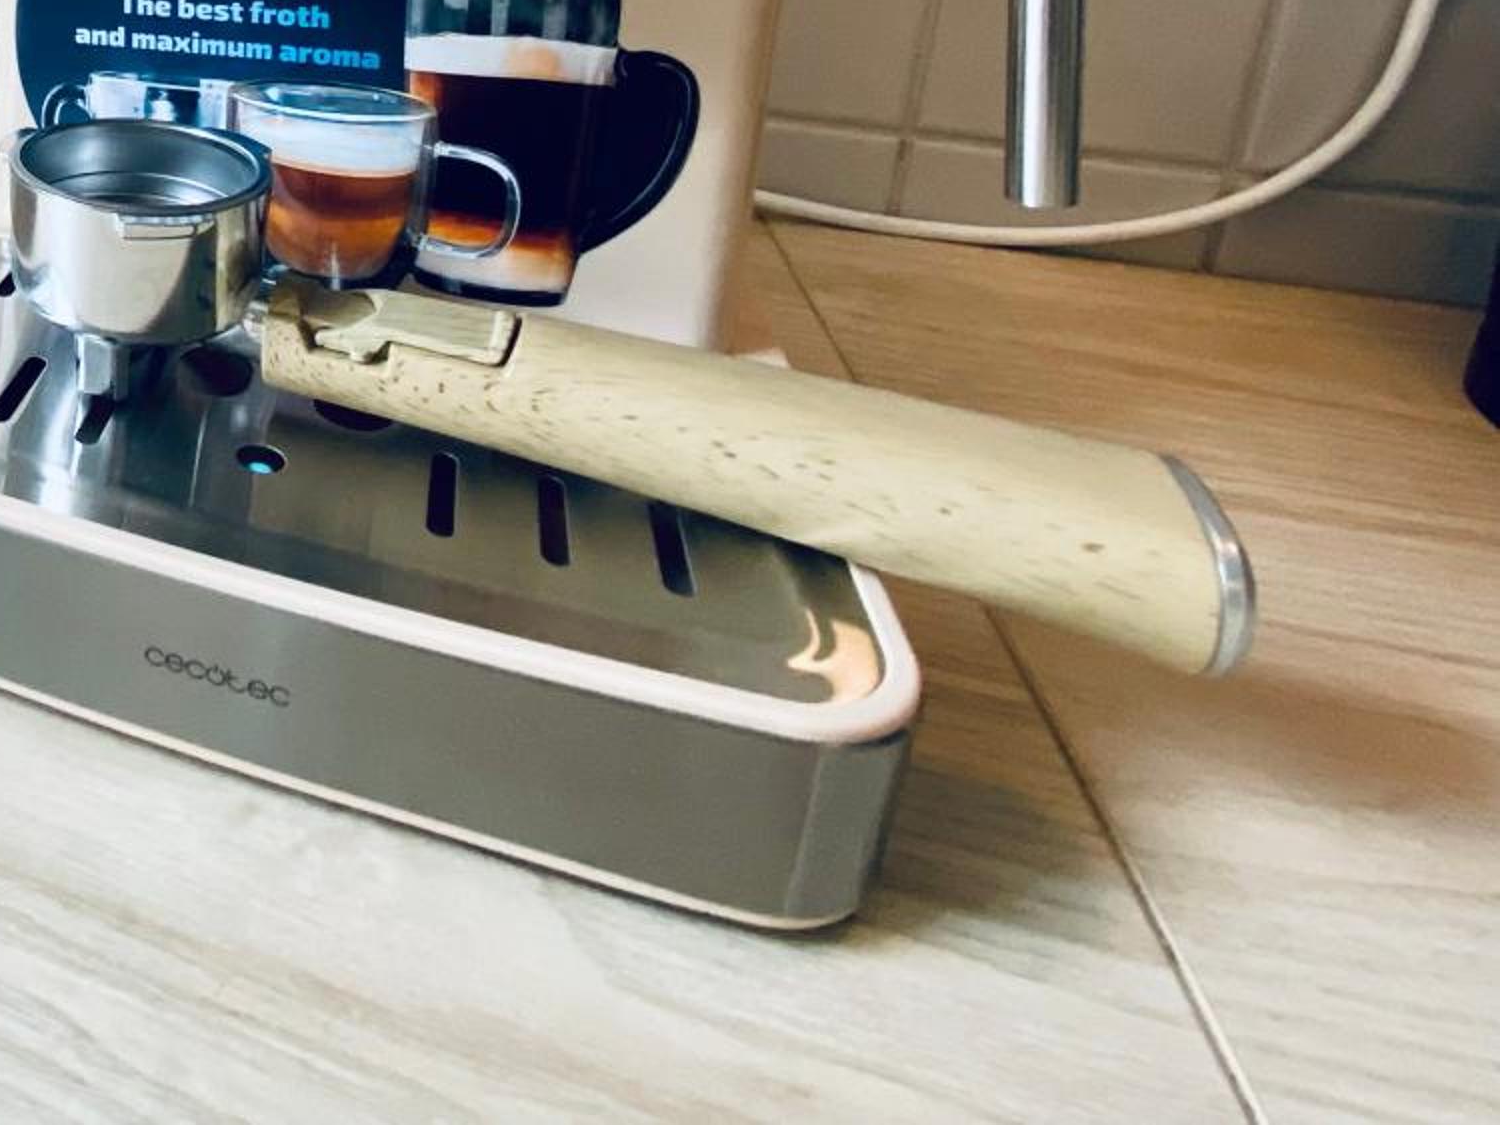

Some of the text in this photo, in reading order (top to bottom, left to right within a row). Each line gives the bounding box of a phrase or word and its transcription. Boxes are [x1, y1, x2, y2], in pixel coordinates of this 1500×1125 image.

[250, 1, 330, 29] froth
[75, 26, 381, 70] and maximum aroma
[144, 646, 290, 707] cecotec
